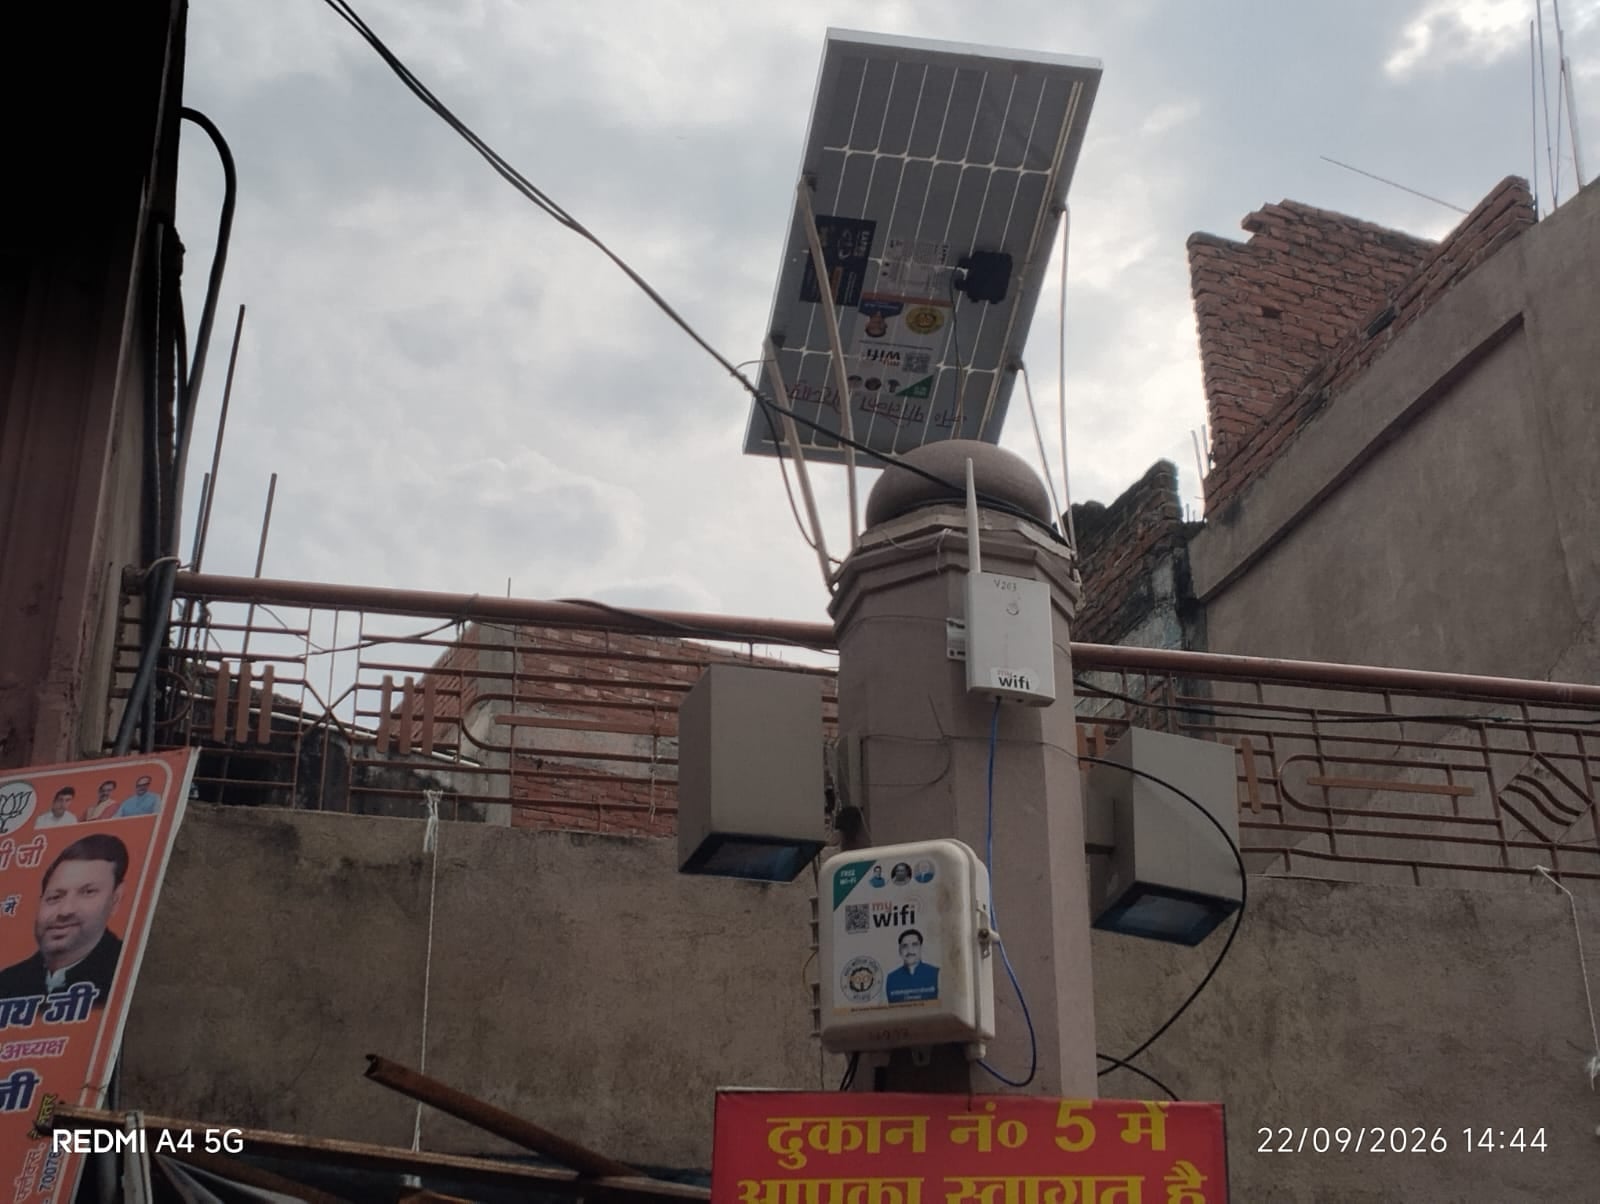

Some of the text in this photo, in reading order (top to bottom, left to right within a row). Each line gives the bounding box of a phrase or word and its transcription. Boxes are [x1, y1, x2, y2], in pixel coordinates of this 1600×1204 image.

[867, 349, 901, 361] wifi
[998, 675, 1031, 690] wifi
[17, 836, 46, 867] जी
[871, 900, 893, 913] my
[873, 903, 916, 928] wifi
[44, 982, 99, 1023] जी
[1, 1037, 69, 1060] अध्यक्ष
[767, 1116, 931, 1169] दुकान
[1055, 1099, 1097, 1152] 5
[737, 1160, 1208, 1204] आपका स्वागत है
